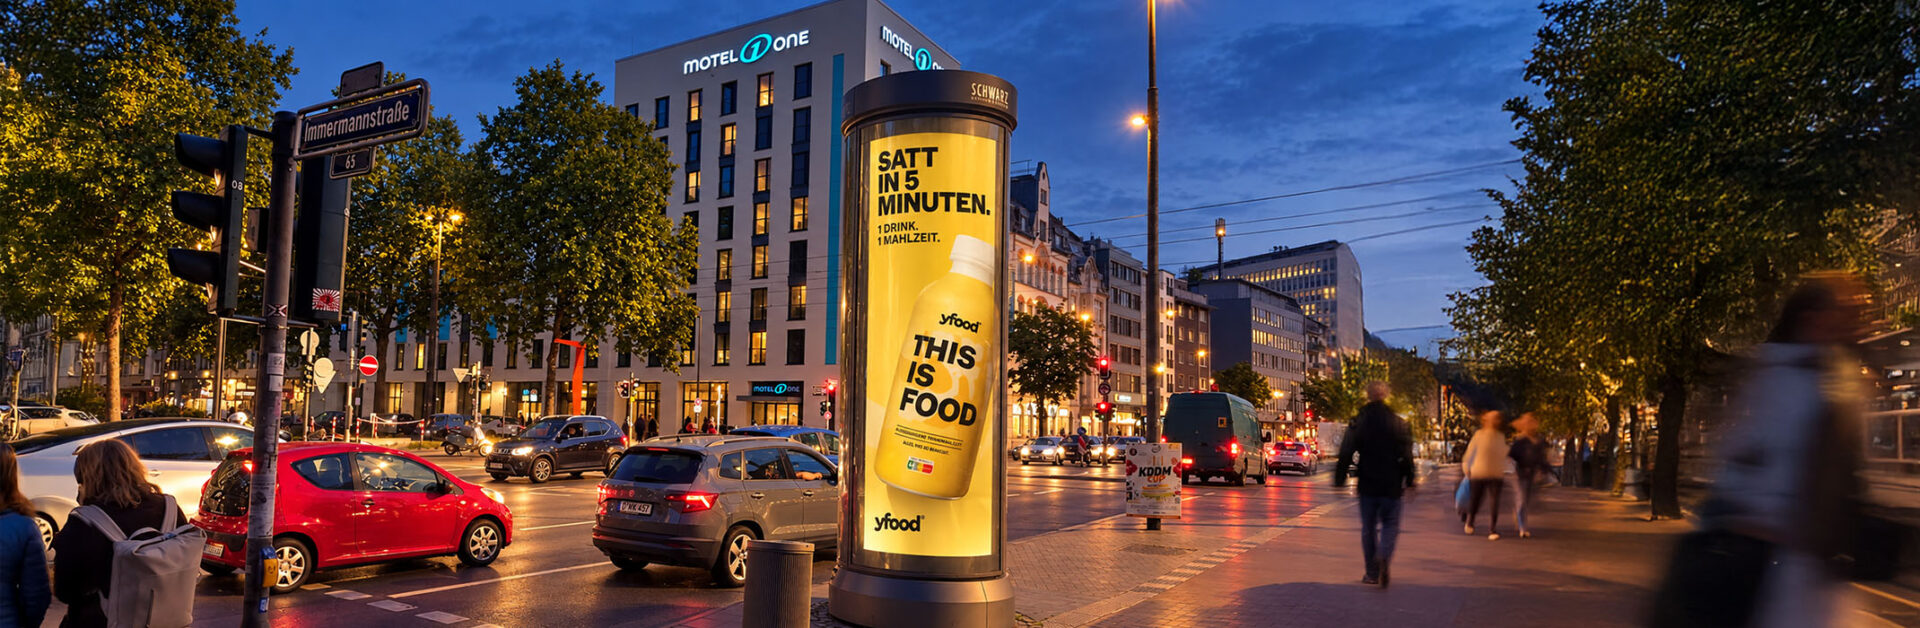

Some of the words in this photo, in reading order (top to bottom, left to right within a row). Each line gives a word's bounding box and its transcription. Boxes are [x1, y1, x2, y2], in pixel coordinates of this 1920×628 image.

[683, 49, 739, 75] MOTEL
[773, 29, 810, 52] ONE
[883, 26, 915, 61] MOTEL
[971, 82, 1010, 105] SCHWARZ
[304, 100, 410, 142] Immermannstraße
[345, 154, 357, 170] 65
[878, 146, 939, 172] SATT
[878, 171, 899, 194] IN
[904, 169, 919, 191] 5
[878, 191, 991, 217] MINUTEN.
[878, 225, 882, 235] 1
[883, 221, 919, 234] DRINK.
[878, 236, 882, 246] 1
[883, 232, 941, 245] MAHLZEIT.
[914, 334, 977, 370] THIS
[906, 361, 936, 388] IS
[753, 385, 774, 393] MOTEL
[899, 387, 977, 427] FOOD
